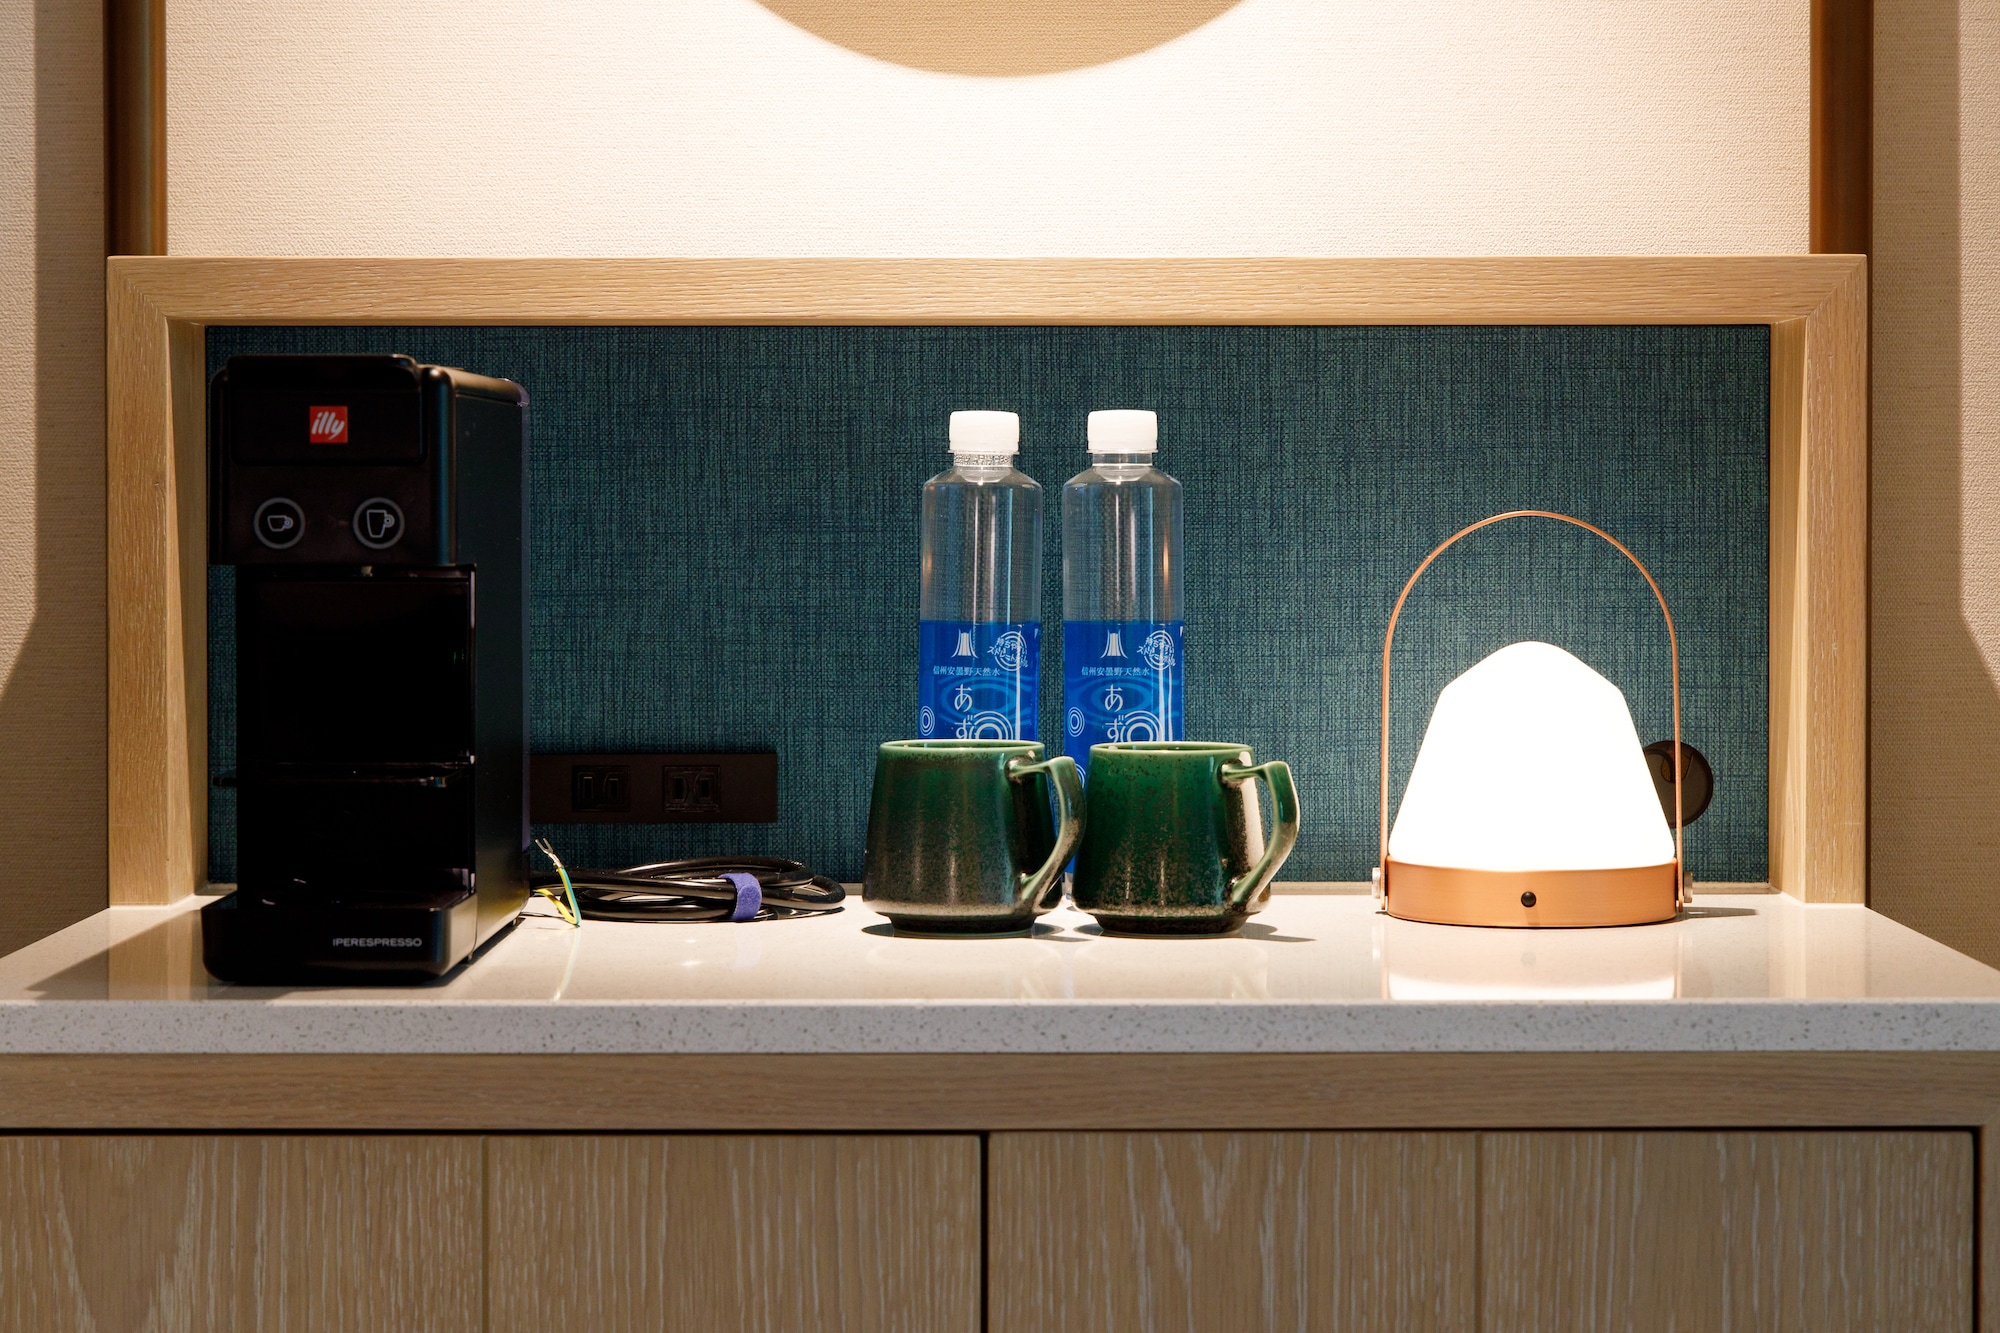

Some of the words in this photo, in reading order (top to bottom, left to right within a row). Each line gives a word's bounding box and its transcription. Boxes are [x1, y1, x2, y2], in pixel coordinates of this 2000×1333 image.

[311, 411, 345, 440] illy
[933, 665, 1001, 676] 信州安曇野天然水
[1081, 666, 1150, 676] 信州安曇野天然水
